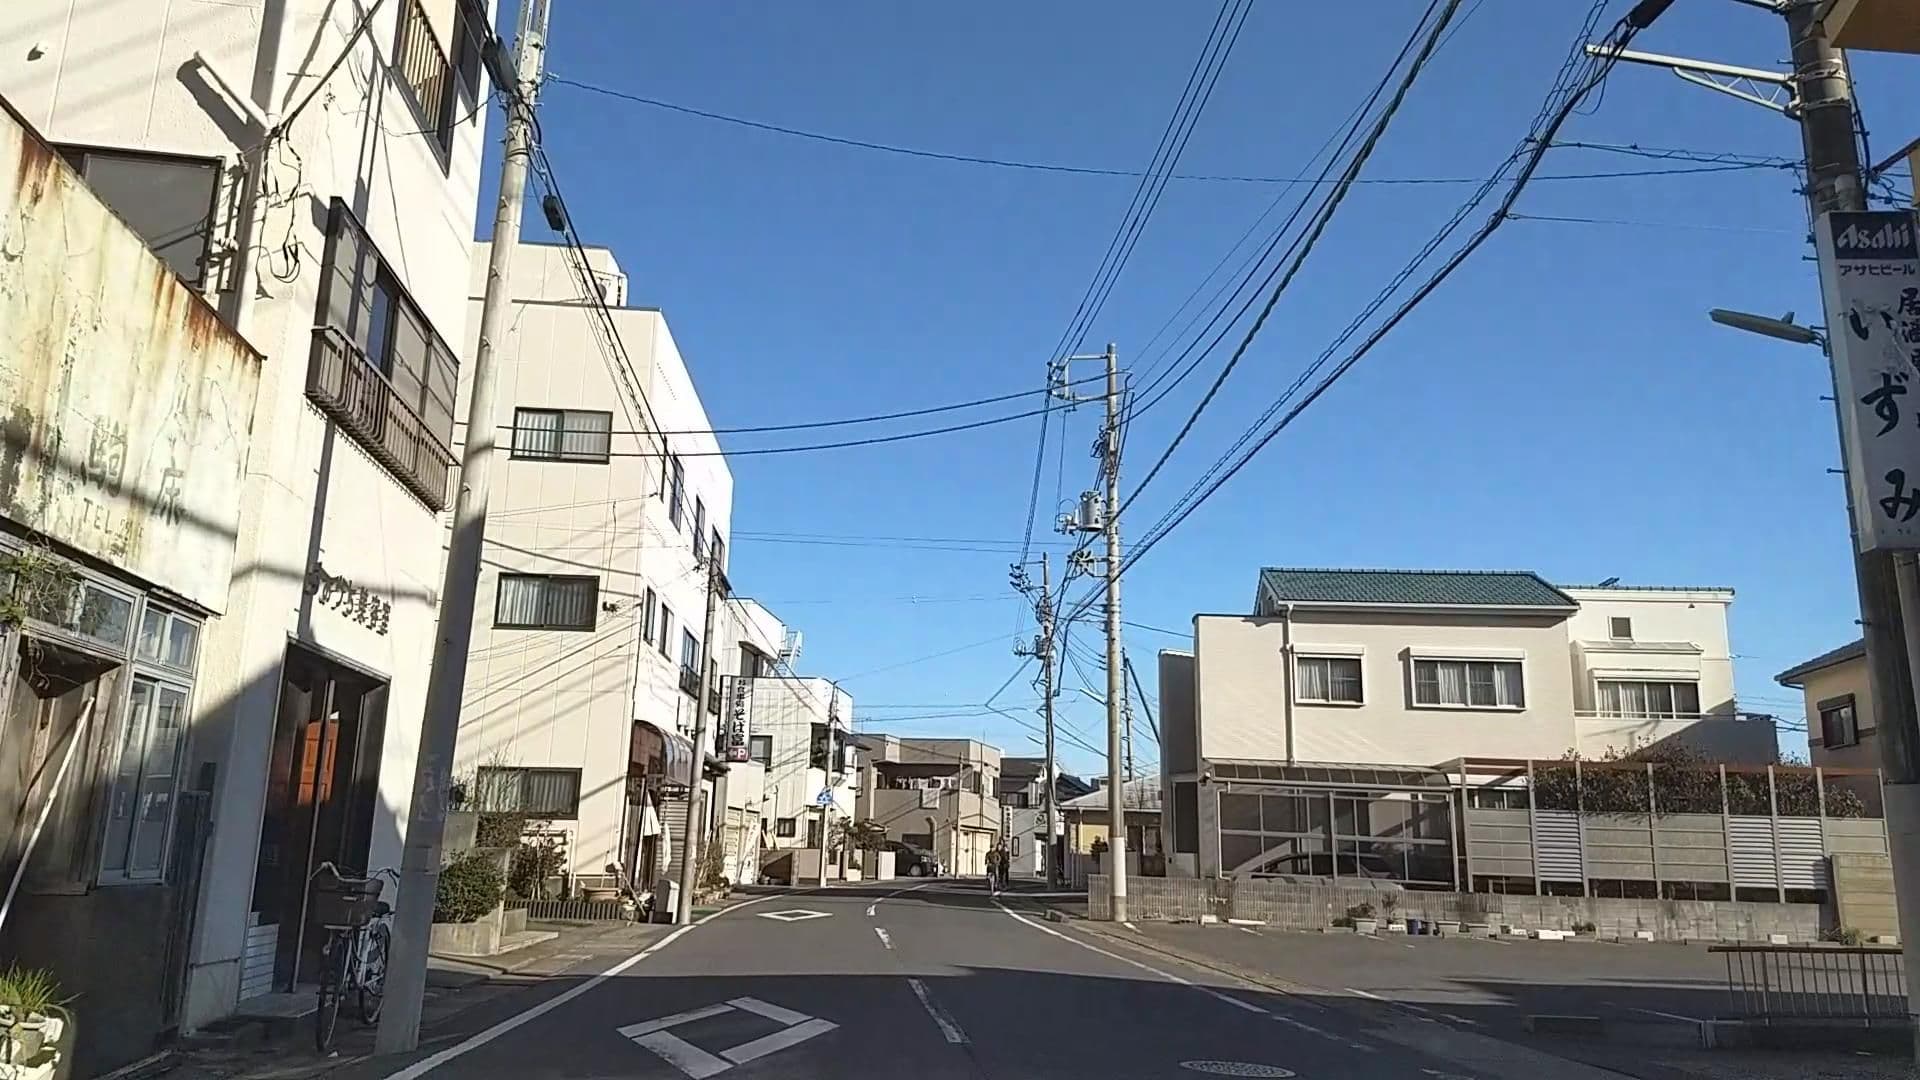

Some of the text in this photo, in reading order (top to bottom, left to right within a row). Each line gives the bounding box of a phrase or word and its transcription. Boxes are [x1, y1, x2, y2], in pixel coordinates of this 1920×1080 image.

[1837, 222, 1909, 249] Asahi
[1839, 263, 1916, 277] アサヒビール
[1849, 307, 1920, 523] いずみ
